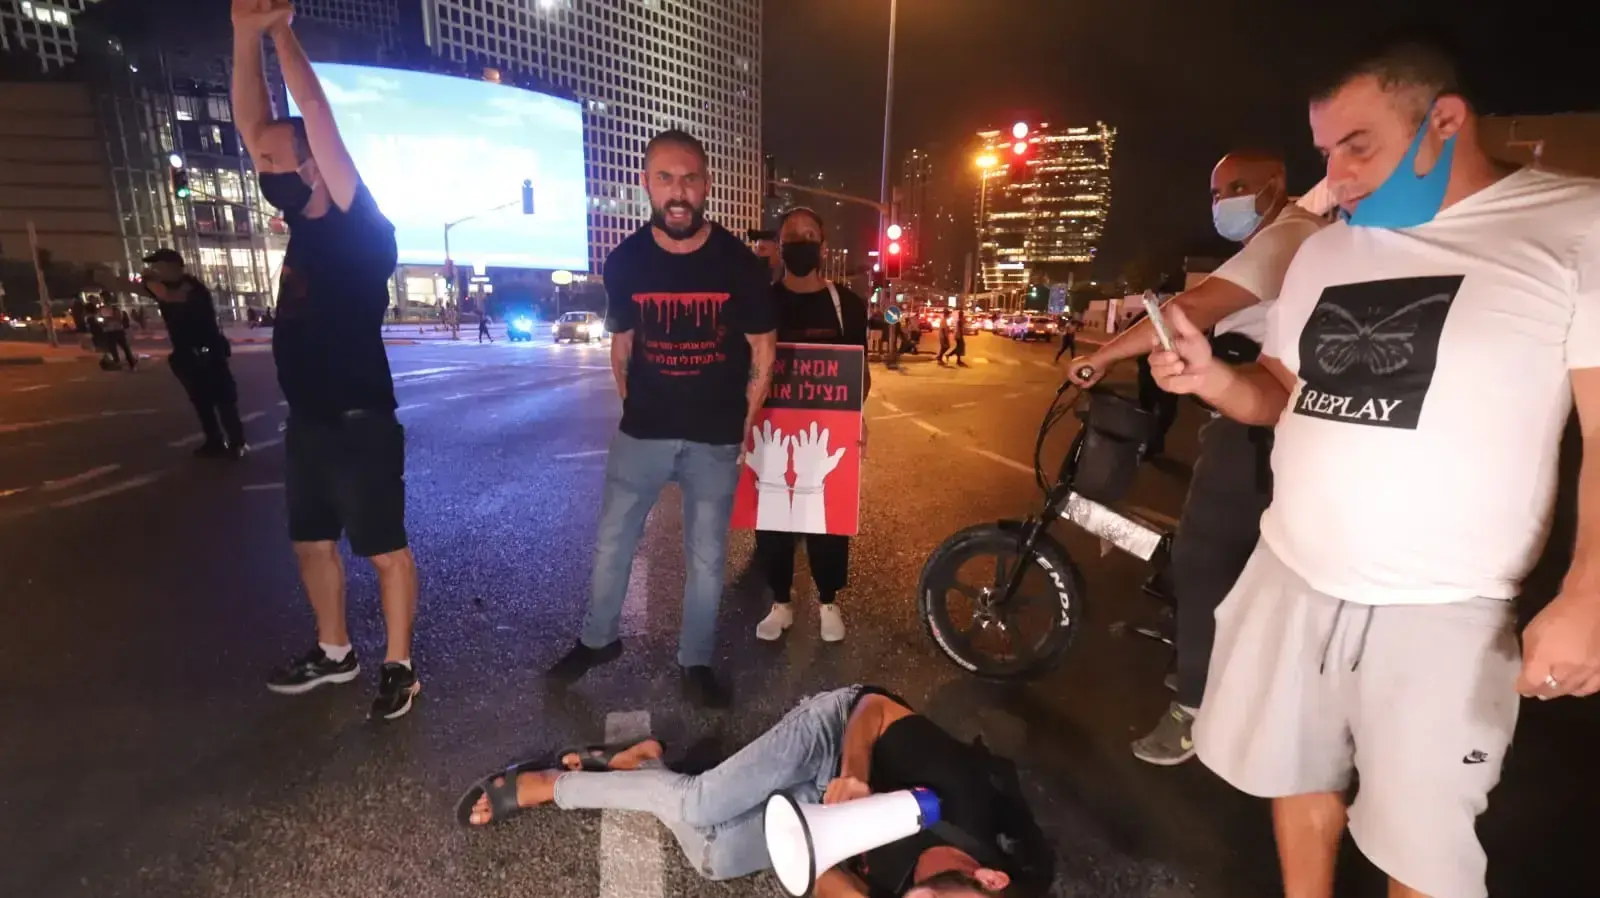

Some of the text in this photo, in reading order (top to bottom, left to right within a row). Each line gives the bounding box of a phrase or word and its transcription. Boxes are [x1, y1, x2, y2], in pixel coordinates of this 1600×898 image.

[666, 355, 678, 366] זה
[690, 353, 714, 365] תגידו
[768, 380, 848, 401] תצילו או
[1302, 390, 1402, 421] REPLAY
